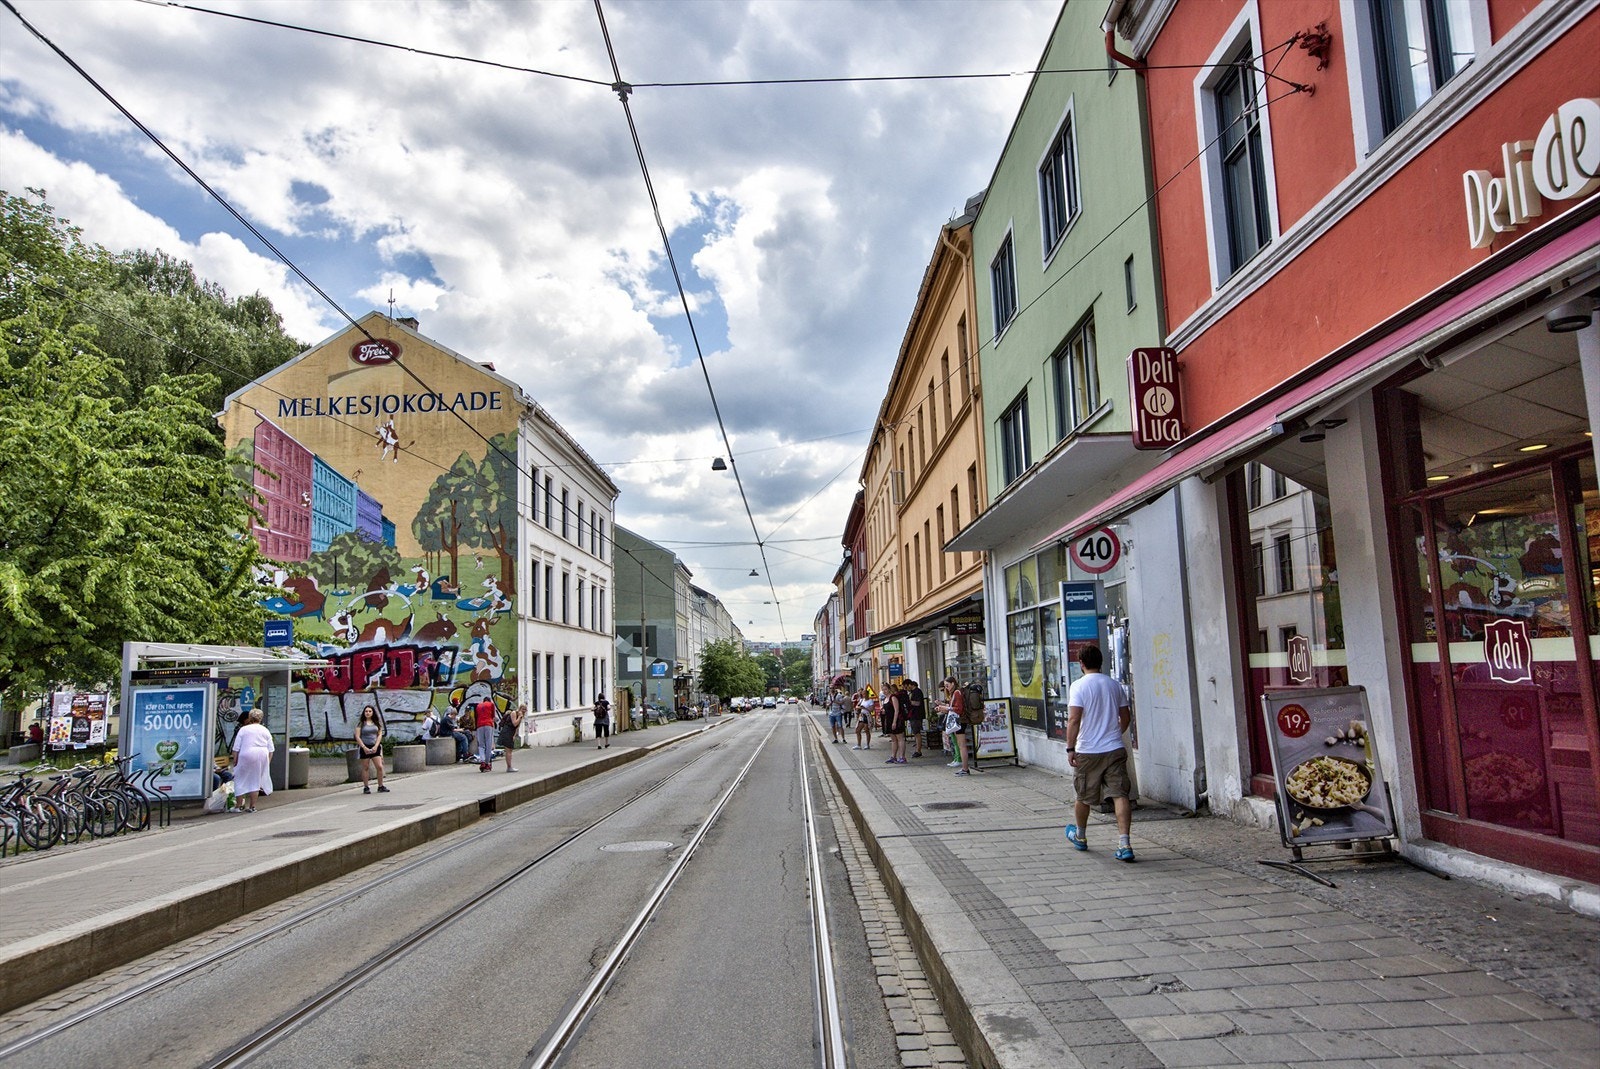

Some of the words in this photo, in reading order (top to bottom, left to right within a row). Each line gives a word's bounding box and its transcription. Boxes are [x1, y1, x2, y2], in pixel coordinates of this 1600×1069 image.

[1463, 140, 1540, 249] Deli
[359, 344, 393, 361] Freia
[1138, 350, 1173, 384] Deli
[278, 391, 502, 418] MELKESJOKOLADE
[1149, 387, 1169, 414] de
[1140, 409, 1180, 442] Luca
[1080, 536, 1112, 560] 40
[1292, 644, 1308, 672] deli
[1493, 629, 1522, 669] deli
[1284, 714, 1310, 730] 19,-
